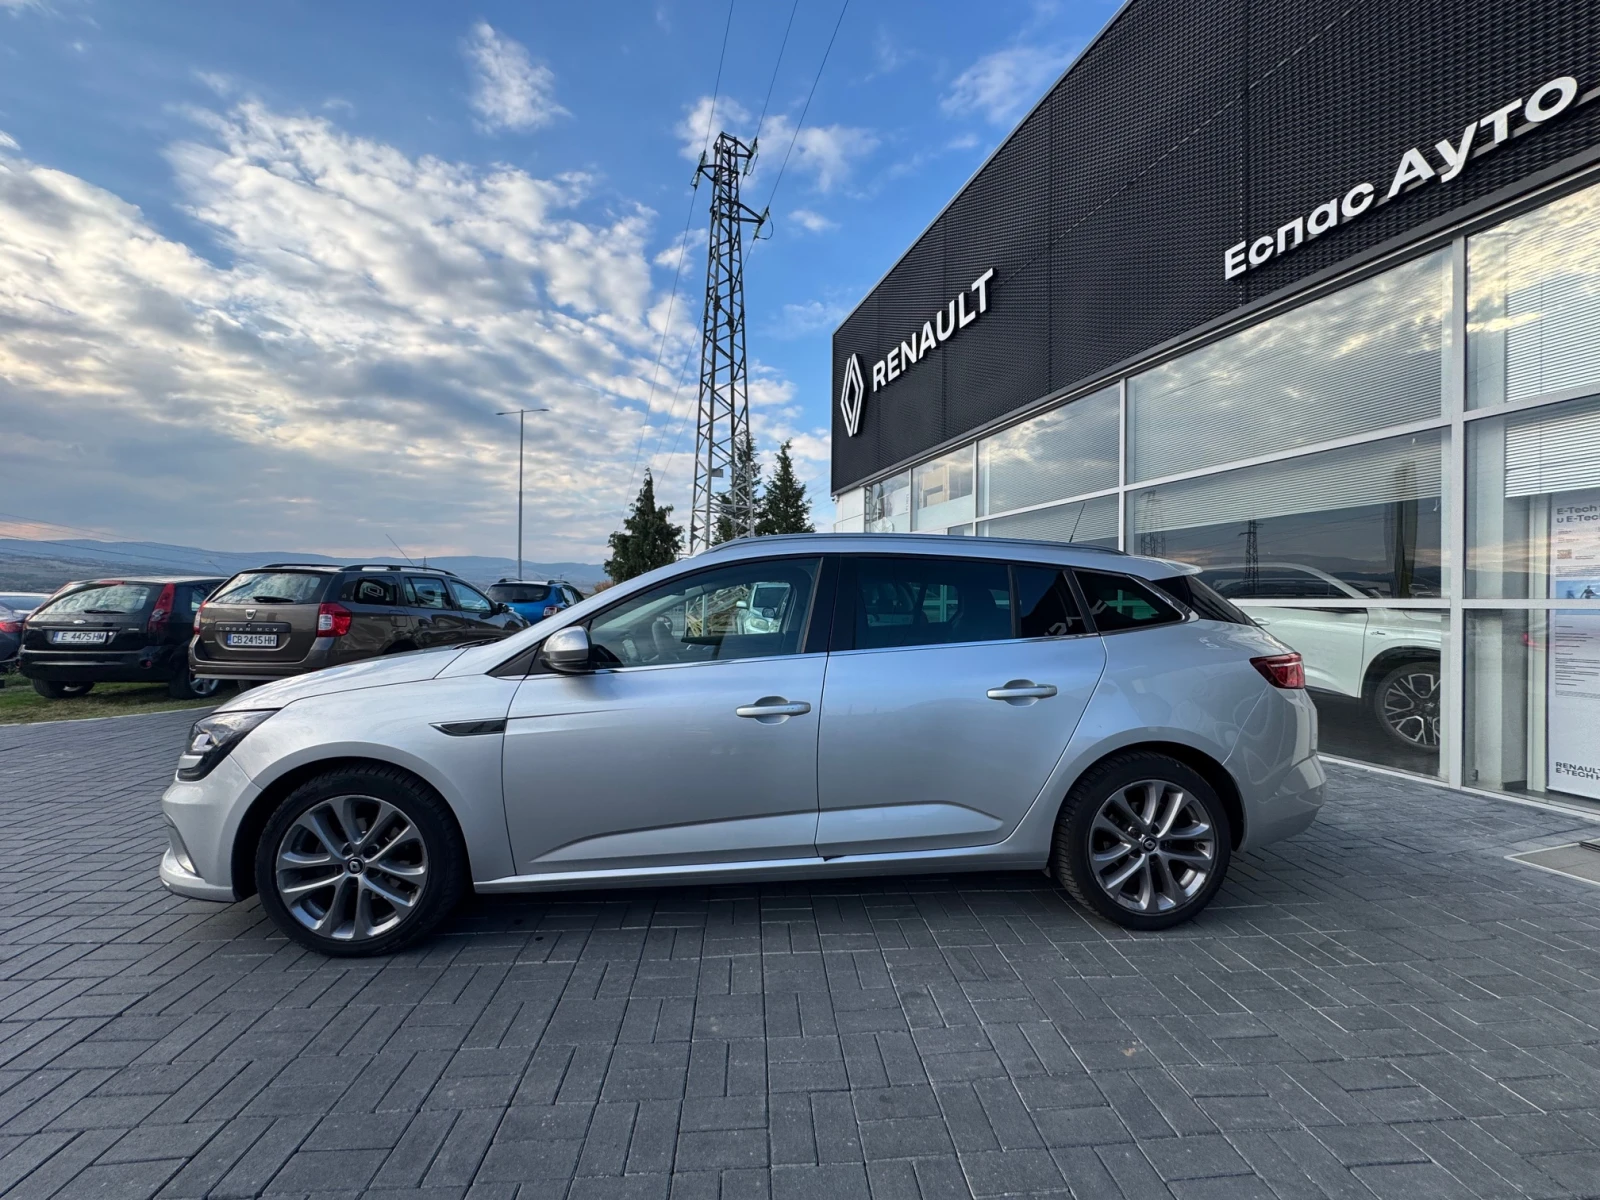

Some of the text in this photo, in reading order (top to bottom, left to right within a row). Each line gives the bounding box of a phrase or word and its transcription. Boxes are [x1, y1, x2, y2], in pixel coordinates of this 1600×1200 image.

[1225, 76, 1578, 281] Еспас Ауто
[872, 267, 994, 393] RENAULT
[1556, 504, 1597, 515] E-Tech
[1566, 514, 1600, 523] E-Tec
[61, 632, 68, 641] E
[71, 632, 92, 641] 4475
[232, 635, 242, 644] CB
[243, 635, 263, 645] 2415
[1555, 768, 1594, 779] E-TECH
